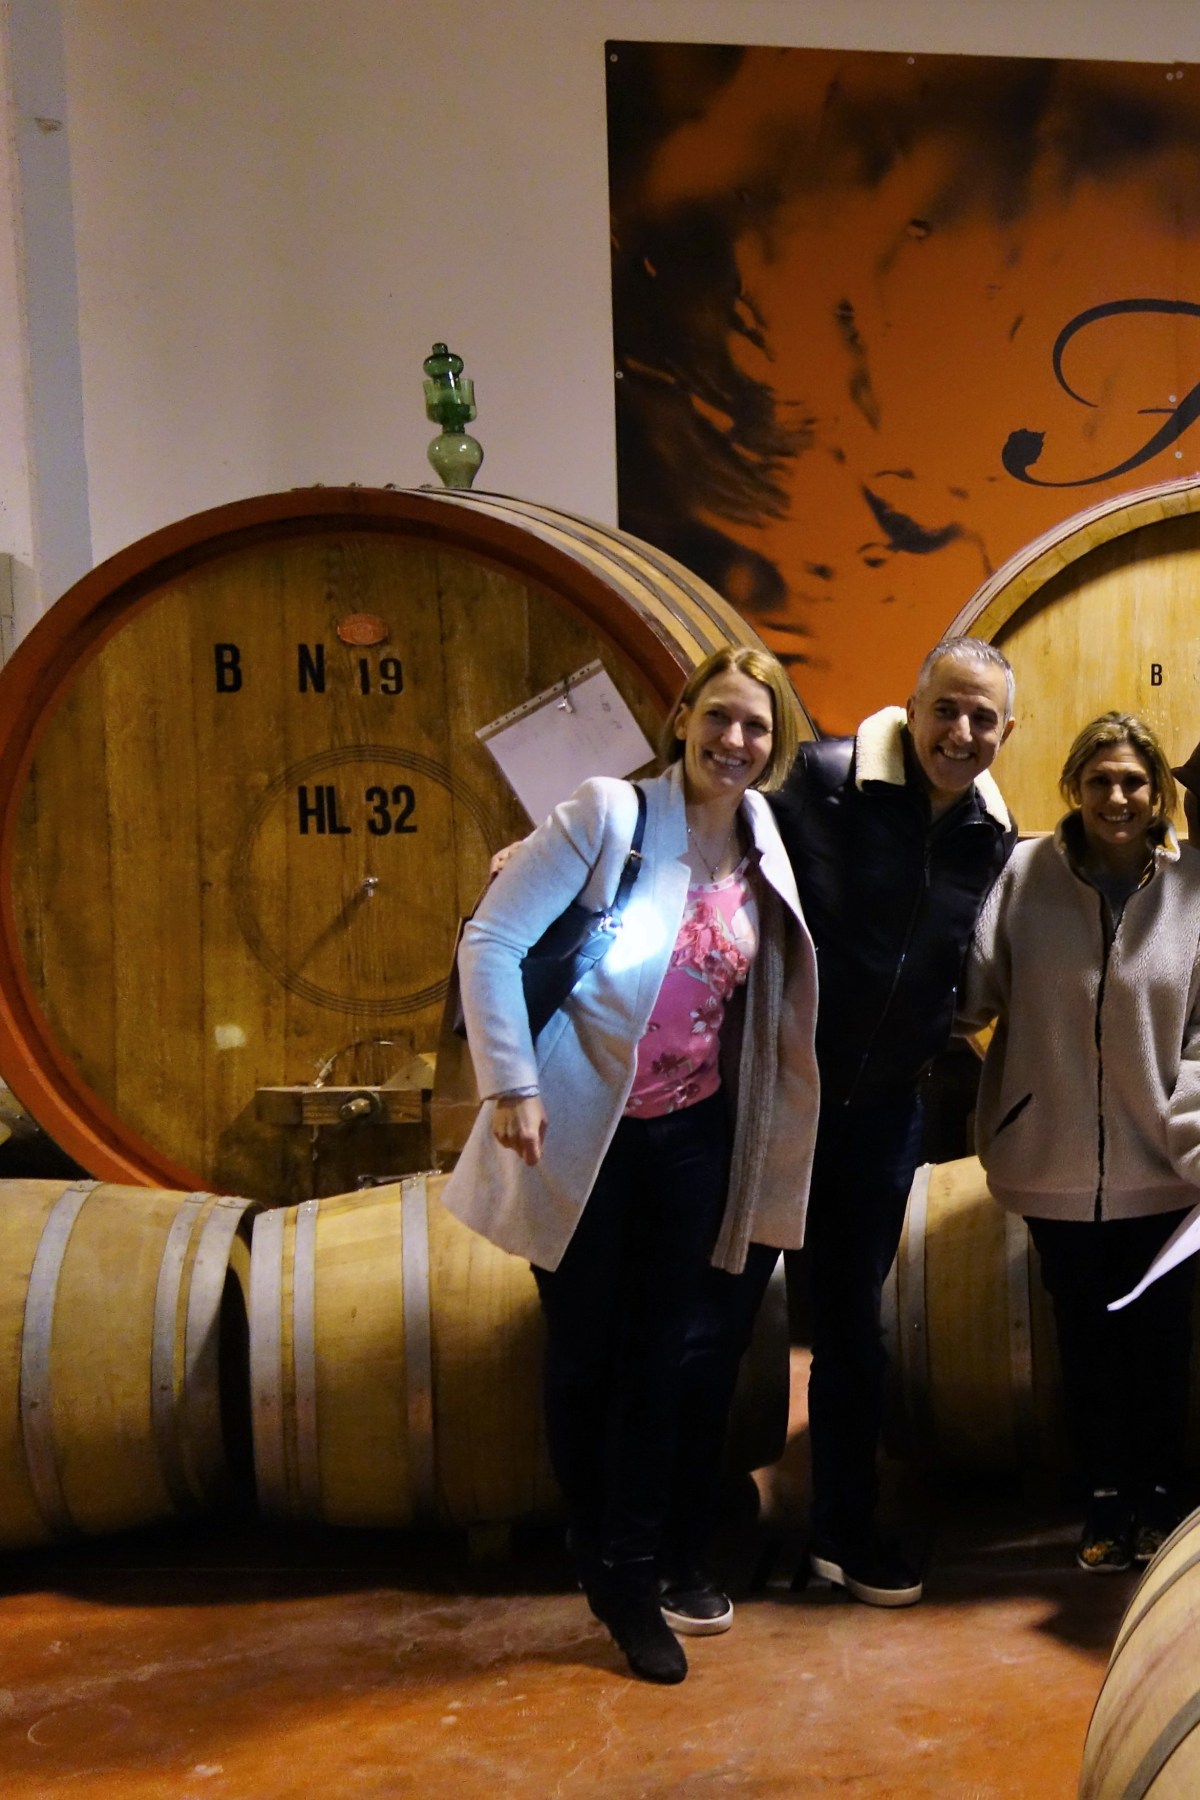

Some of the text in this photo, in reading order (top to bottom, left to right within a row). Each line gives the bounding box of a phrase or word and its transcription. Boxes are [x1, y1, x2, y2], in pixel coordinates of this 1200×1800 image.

[214, 643, 404, 695] B N 19
[1151, 663, 1163, 686] B
[298, 785, 418, 836] HL 32
